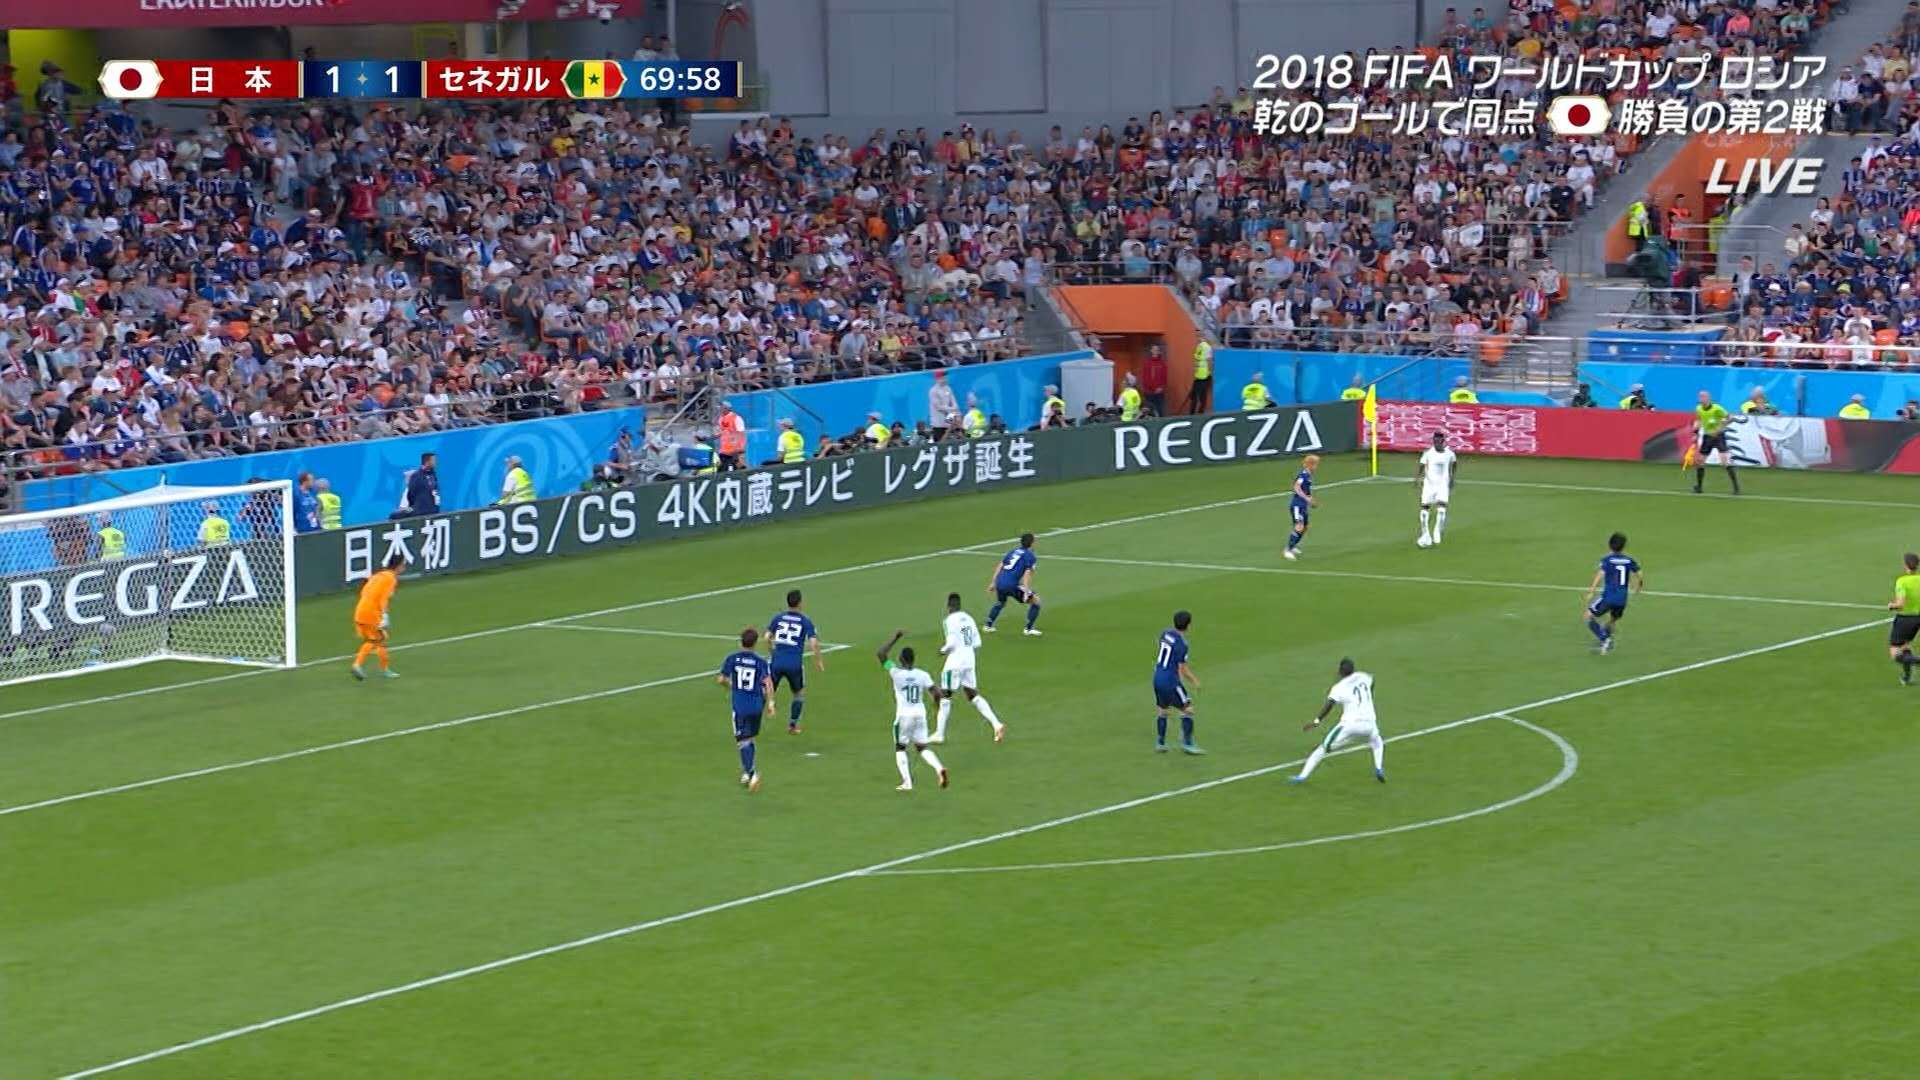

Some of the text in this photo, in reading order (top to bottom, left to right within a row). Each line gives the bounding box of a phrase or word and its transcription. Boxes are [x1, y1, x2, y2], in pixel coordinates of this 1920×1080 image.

[1114, 410, 1323, 470] REGZA
[479, 490, 636, 560] BS/CS
[657, 457, 855, 528] 4K内蔵テレビ
[884, 437, 1036, 494] レグザ誕生
[9, 550, 259, 636] REGZA
[775, 621, 802, 646] 22
[734, 665, 756, 691] 19
